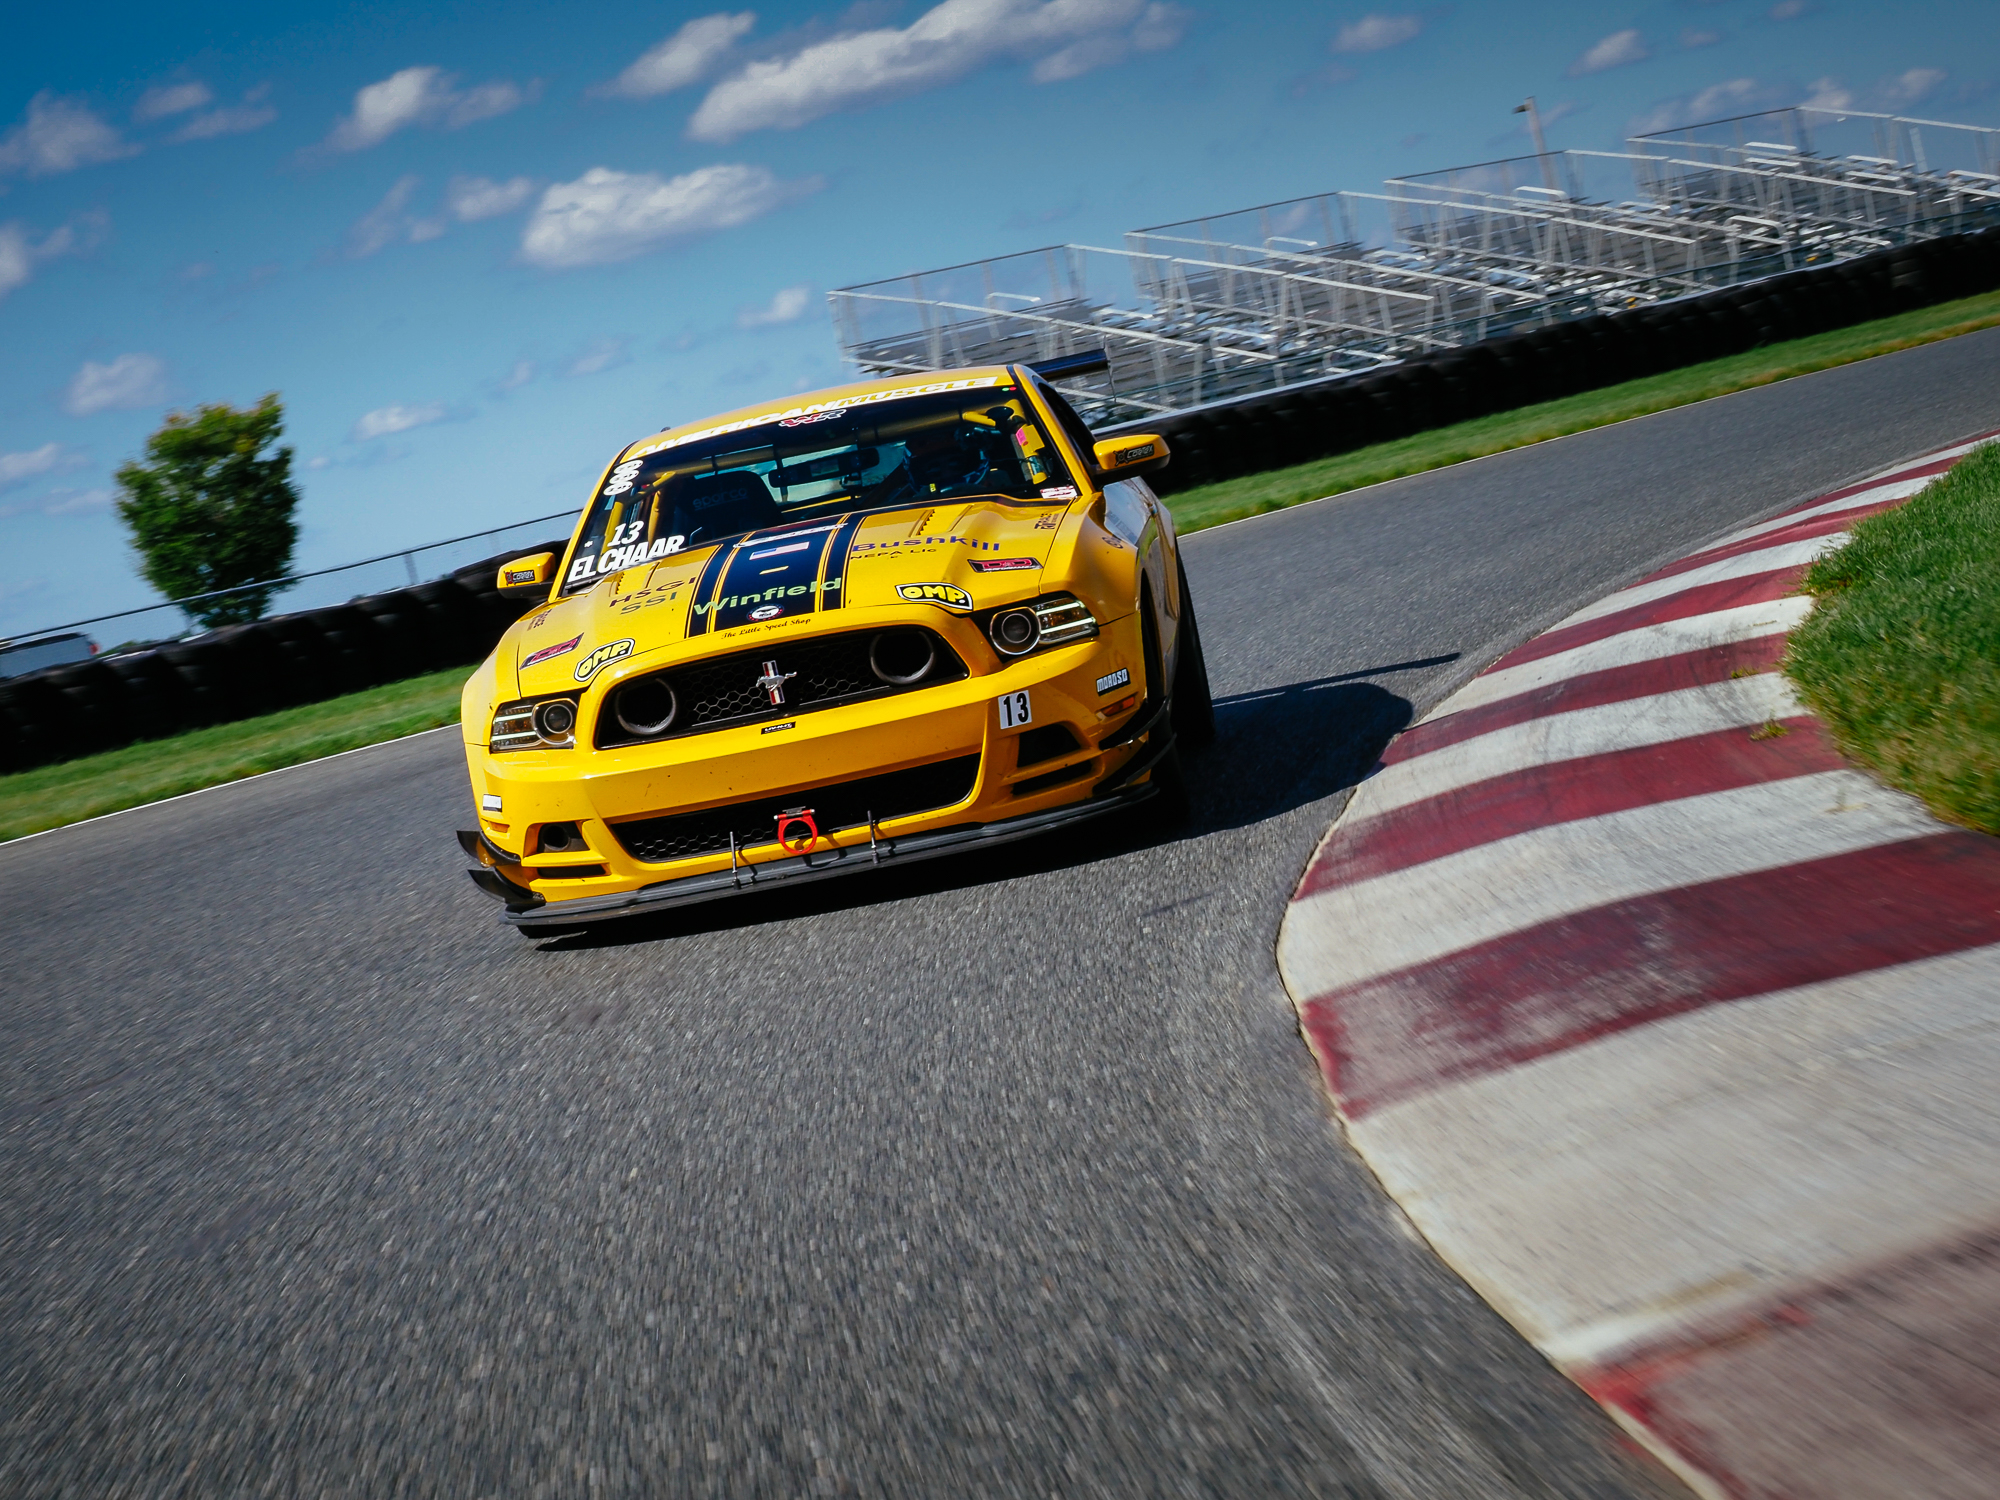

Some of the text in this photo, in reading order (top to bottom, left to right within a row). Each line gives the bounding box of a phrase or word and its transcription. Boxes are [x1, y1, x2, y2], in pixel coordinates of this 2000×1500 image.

[608, 521, 644, 547] 13
[853, 535, 1000, 552] Bushkill
[567, 535, 687, 583] EL CHAAR
[609, 577, 696, 607] HSGI
[620, 592, 677, 615] SSI
[694, 577, 842, 616] Winfield
[721, 617, 811, 640] The Little Speed Shop
[1096, 668, 1128, 692] MOROSO
[1003, 692, 1029, 727] 13
